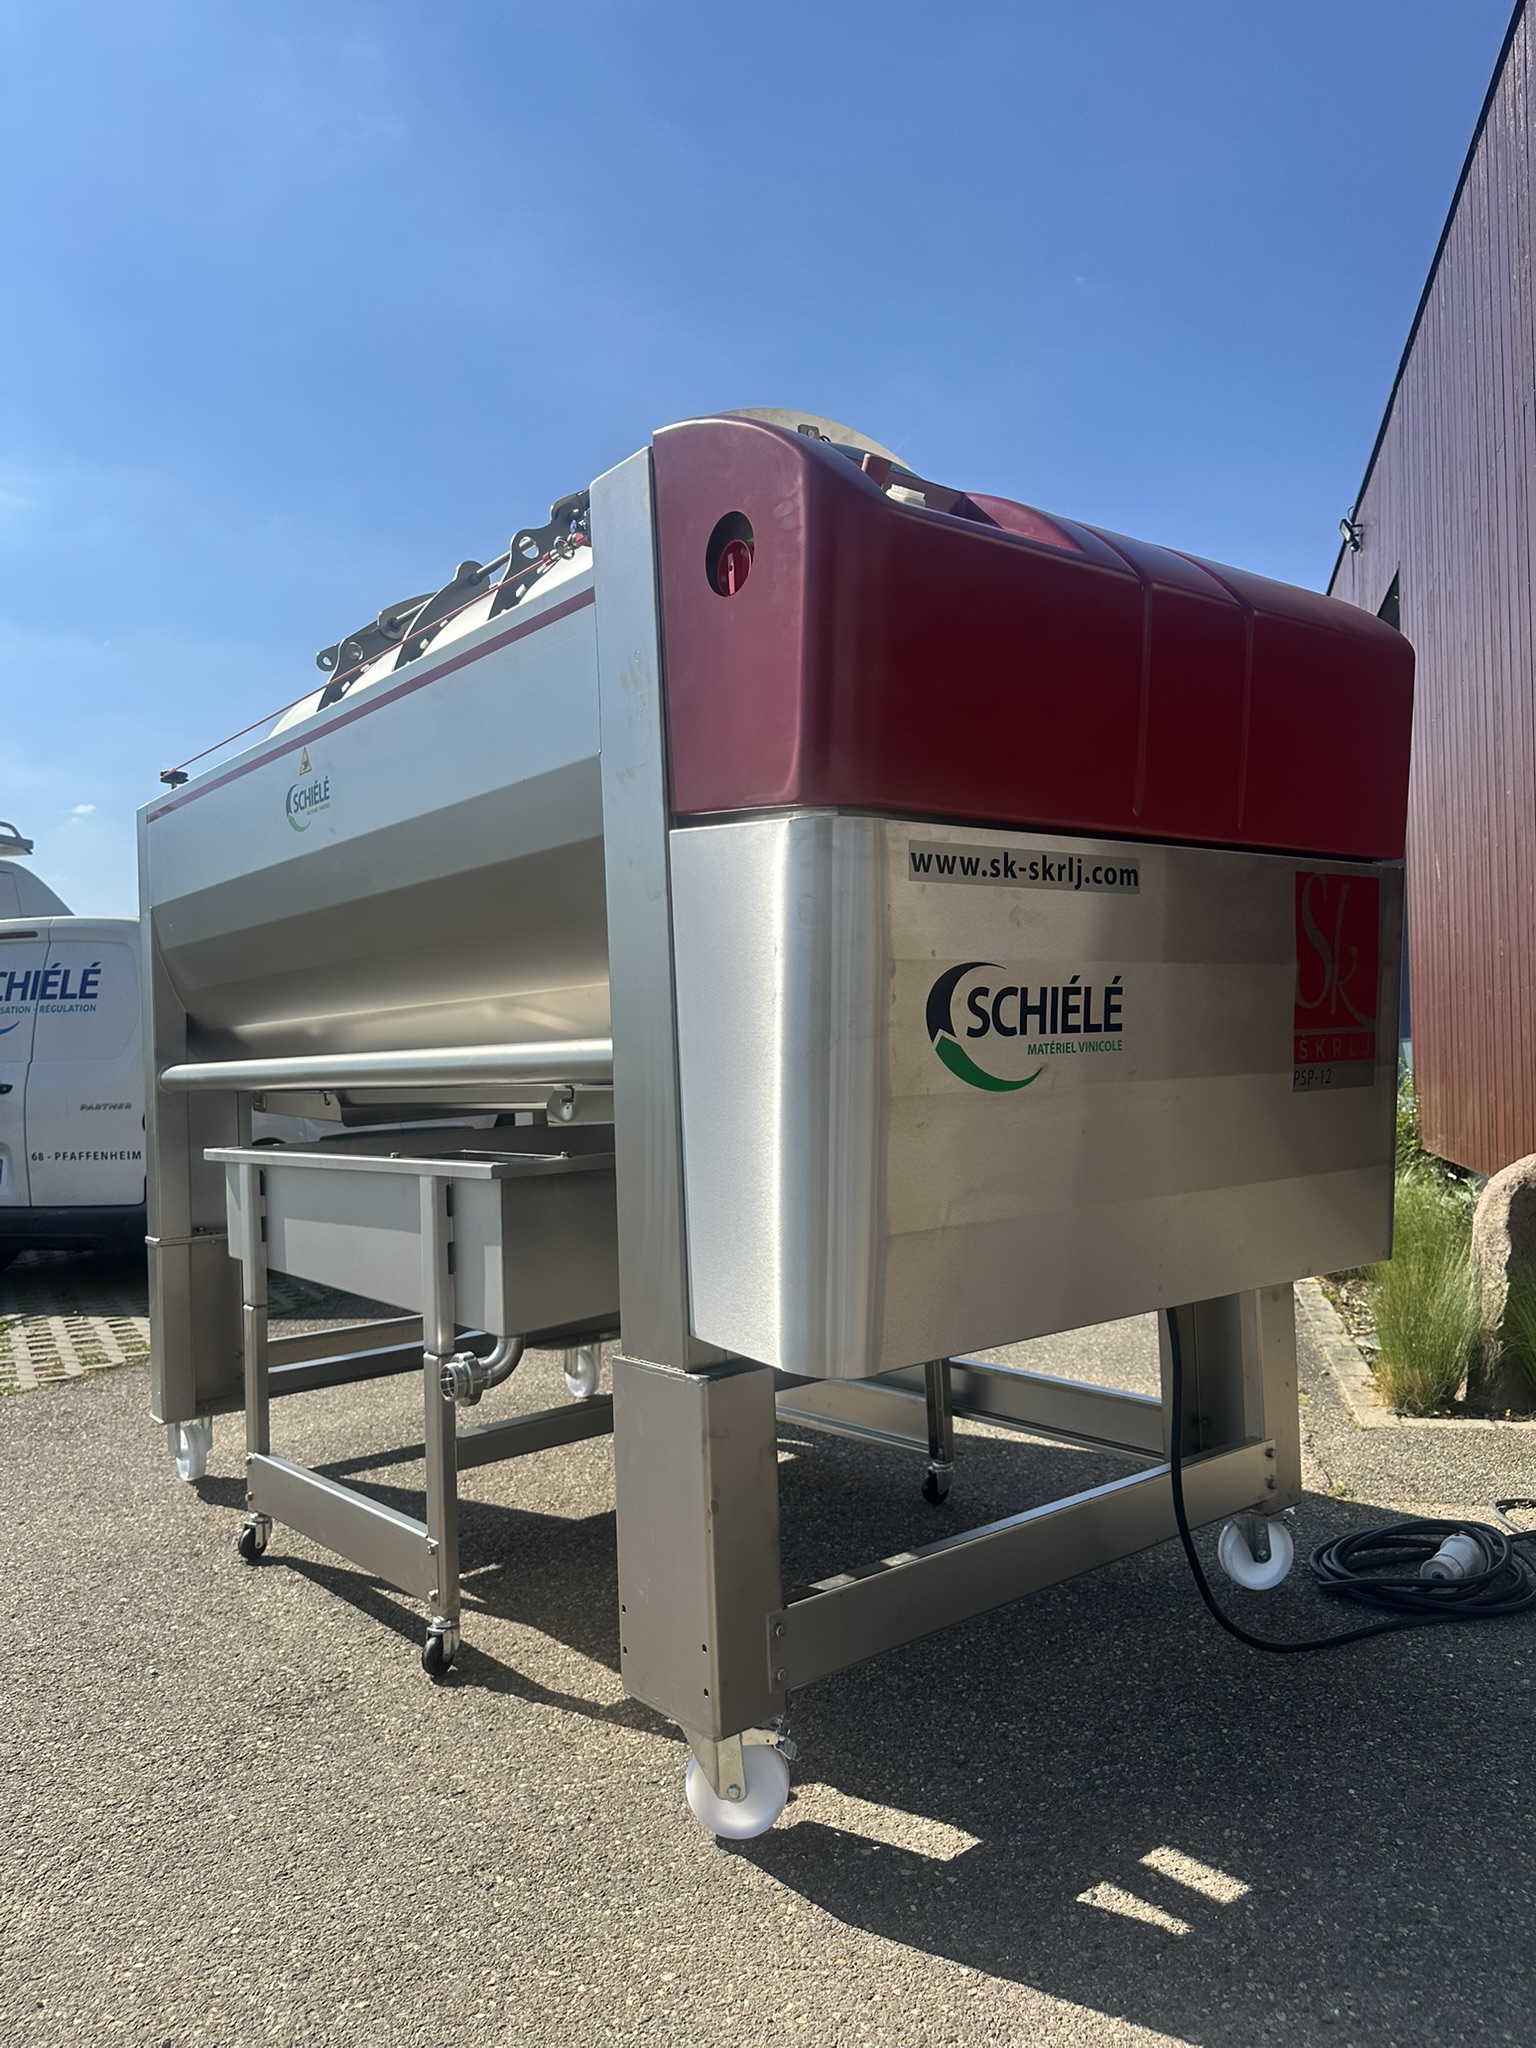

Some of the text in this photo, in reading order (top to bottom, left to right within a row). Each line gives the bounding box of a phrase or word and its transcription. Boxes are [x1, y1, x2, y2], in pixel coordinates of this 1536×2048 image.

[293, 775, 330, 813] SCHIÉLÉ
[911, 852, 1139, 890] www.sk-skrlj.com
[39, 1004, 97, 1014] RÉGULATION
[966, 975, 1124, 1038] SCHIÉLÉ
[1027, 1039, 1123, 1056] MATÉRIEL VINICOLE
[1293, 1068, 1333, 1087] PSP-12
[80, 1102, 132, 1111] PARTNER
[31, 1152, 45, 1161] 68
[55, 1151, 142, 1161] PFAFFENHEIM
